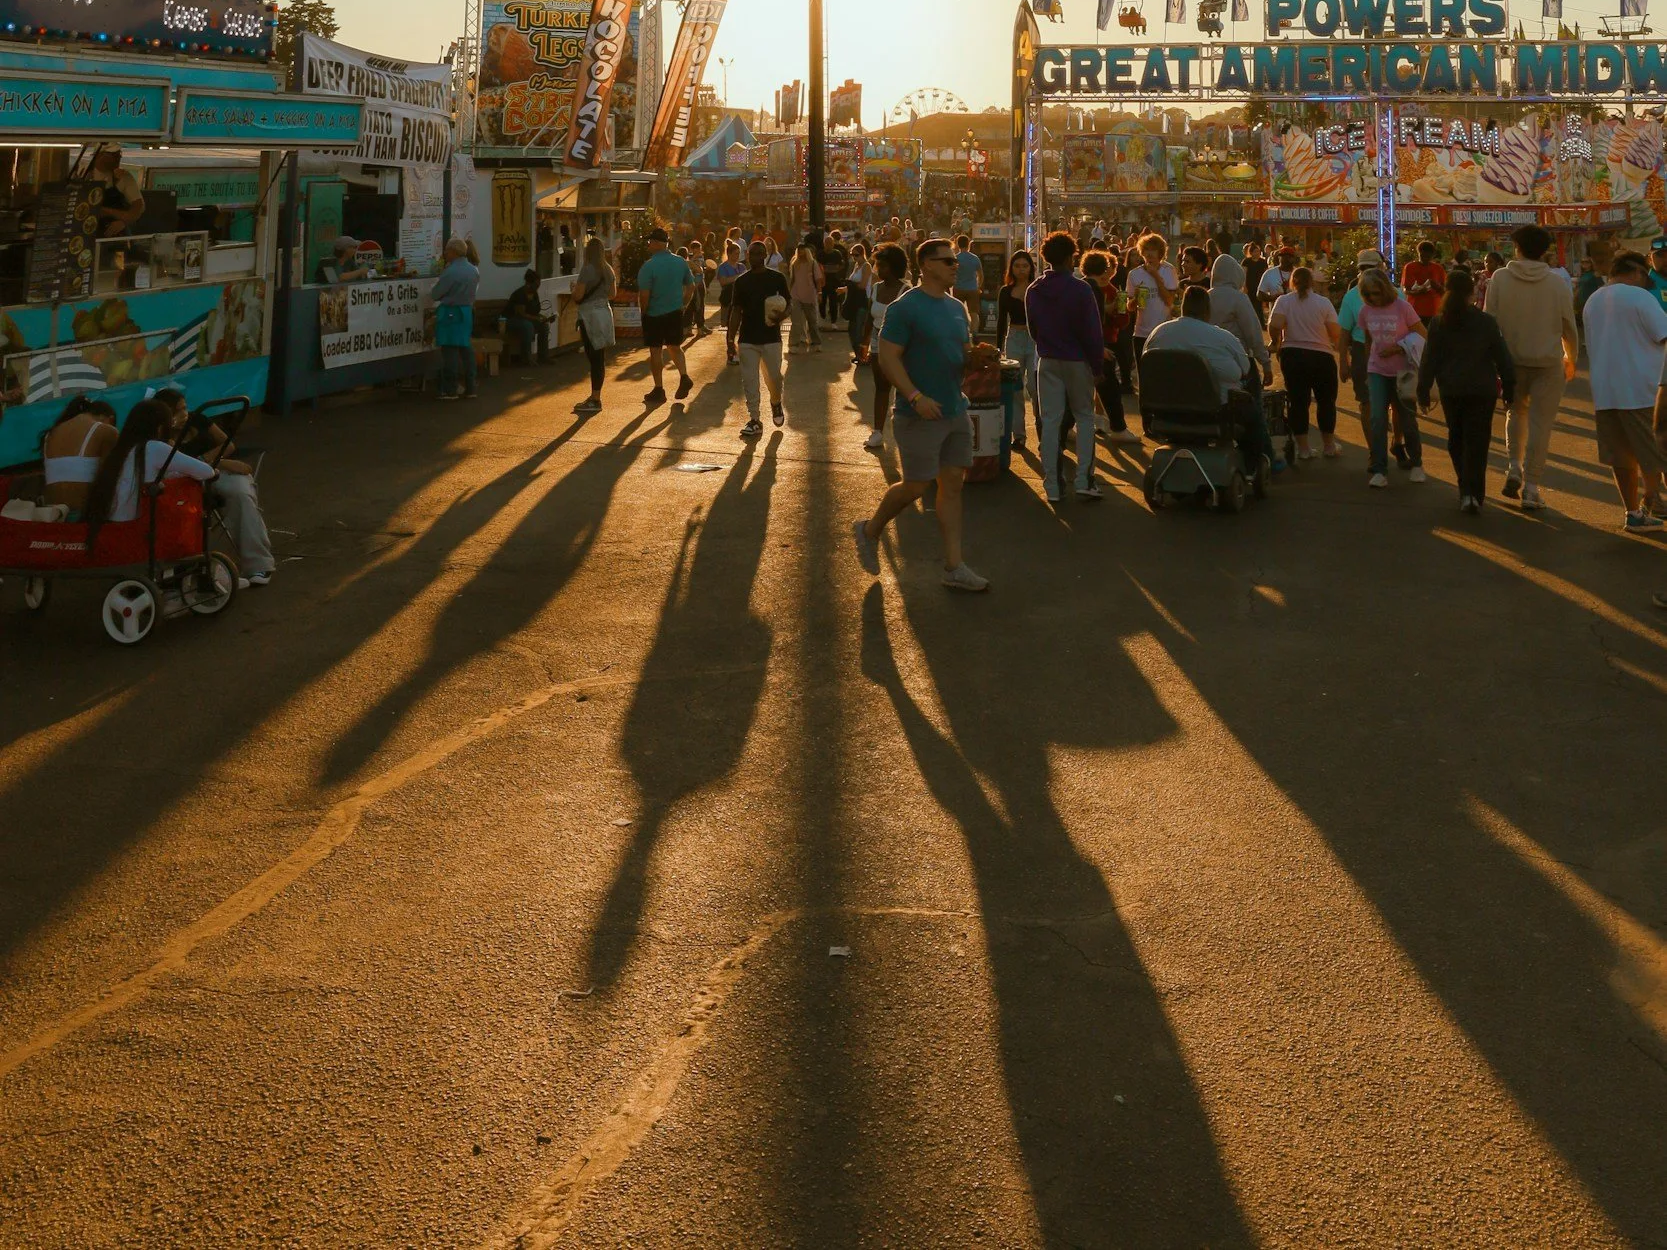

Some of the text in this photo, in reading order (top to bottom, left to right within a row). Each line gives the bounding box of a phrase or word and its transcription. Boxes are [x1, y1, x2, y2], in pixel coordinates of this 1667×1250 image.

[505, 2, 590, 31] TURKE
[308, 57, 345, 91] DEEP
[347, 64, 387, 99] FRIED
[1033, 46, 1199, 94] GREAT
[1215, 45, 1496, 94] AMERICAN
[531, 74, 577, 90] Mexica
[71, 92, 94, 118] ON
[98, 95, 110, 117] A
[117, 95, 147, 117] PITA
[506, 84, 572, 107] STRE
[185, 105, 218, 125] GREEK
[223, 107, 255, 126] SALAD
[274, 111, 310, 127] VEGGIES
[314, 111, 326, 129] ON
[374, 135, 397, 160] HAM
[1315, 120, 1367, 159] ICE
[1358, 209, 1432, 223] CONE SUNDAES
[1453, 210, 1537, 224] FRESH SQUEEZED LEMONADE
[980, 227, 1000, 236] ATM
[356, 252, 382, 260] PEPSI
[351, 284, 418, 307] Shrimp & Grits
[387, 305, 395, 316] On
[403, 303, 418, 314] Stick
[353, 333, 372, 353] BBQ
[374, 330, 403, 349] Chicken
[404, 327, 422, 344] Tots
